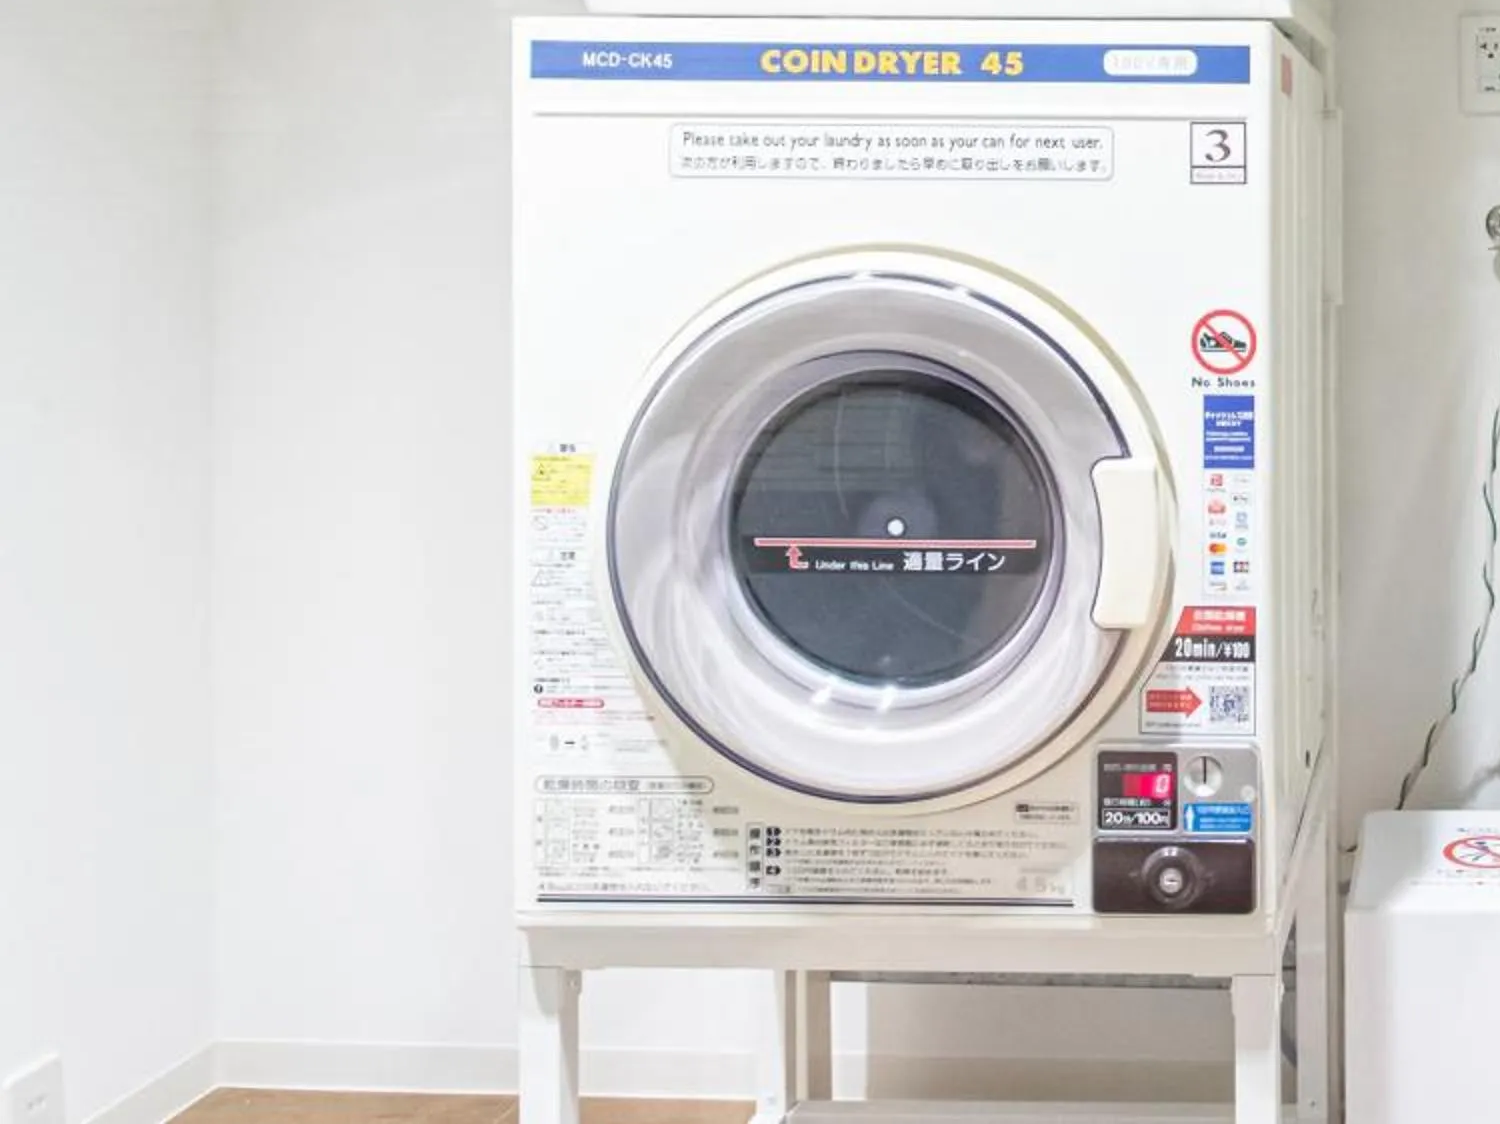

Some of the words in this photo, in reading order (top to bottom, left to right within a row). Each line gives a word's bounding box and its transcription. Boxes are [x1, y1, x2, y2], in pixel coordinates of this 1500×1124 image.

[583, 52, 673, 69] MCD-CK45
[760, 50, 849, 74] COIN
[854, 50, 963, 75] DRYER
[981, 52, 1024, 76] 45
[682, 132, 726, 147] Please
[729, 133, 759, 147] take
[763, 134, 785, 147] out
[789, 135, 819, 151] your
[823, 132, 872, 151] laundry
[877, 136, 891, 148] as
[895, 136, 927, 148] soon
[931, 136, 945, 148] as
[949, 136, 979, 152] your
[983, 136, 1006, 149] can
[1009, 134, 1030, 149] for
[1035, 135, 1065, 149] next
[1072, 137, 1103, 150] user.
[1205, 129, 1231, 162] 3
[1191, 377, 1211, 388] No
[1217, 377, 1255, 388] Shoes
[815, 560, 846, 570] Under
[903, 551, 1005, 571] 適量ライン
